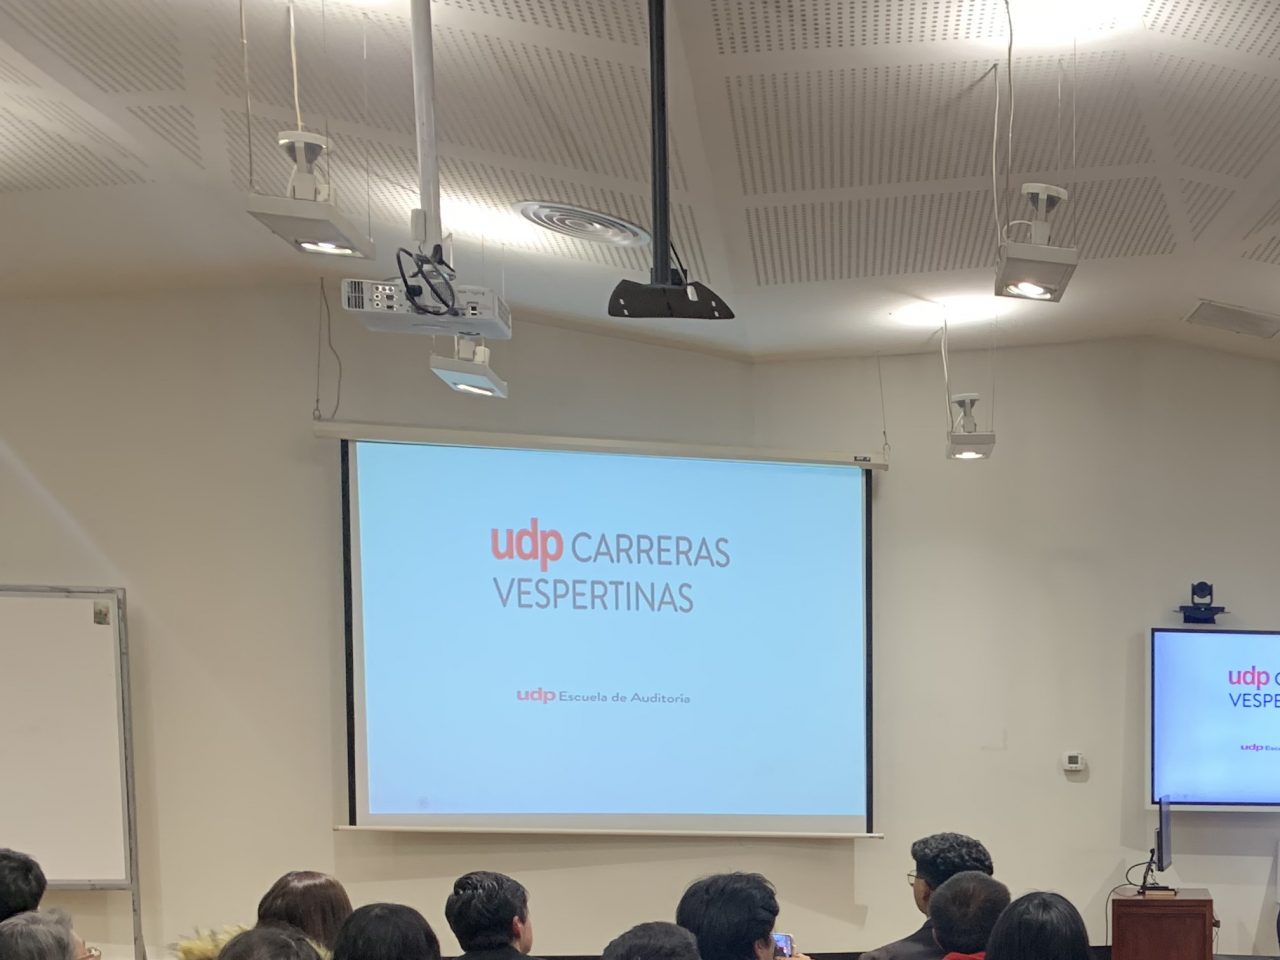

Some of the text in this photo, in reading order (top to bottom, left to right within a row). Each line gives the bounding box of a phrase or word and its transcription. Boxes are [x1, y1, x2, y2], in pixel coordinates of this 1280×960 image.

[490, 517, 731, 572] udp CARRERAS
[493, 577, 694, 613] VESPERTINAS
[1228, 666, 1270, 690] udp
[516, 687, 556, 704] udp
[558, 690, 608, 702] Escuela
[611, 692, 627, 702] de
